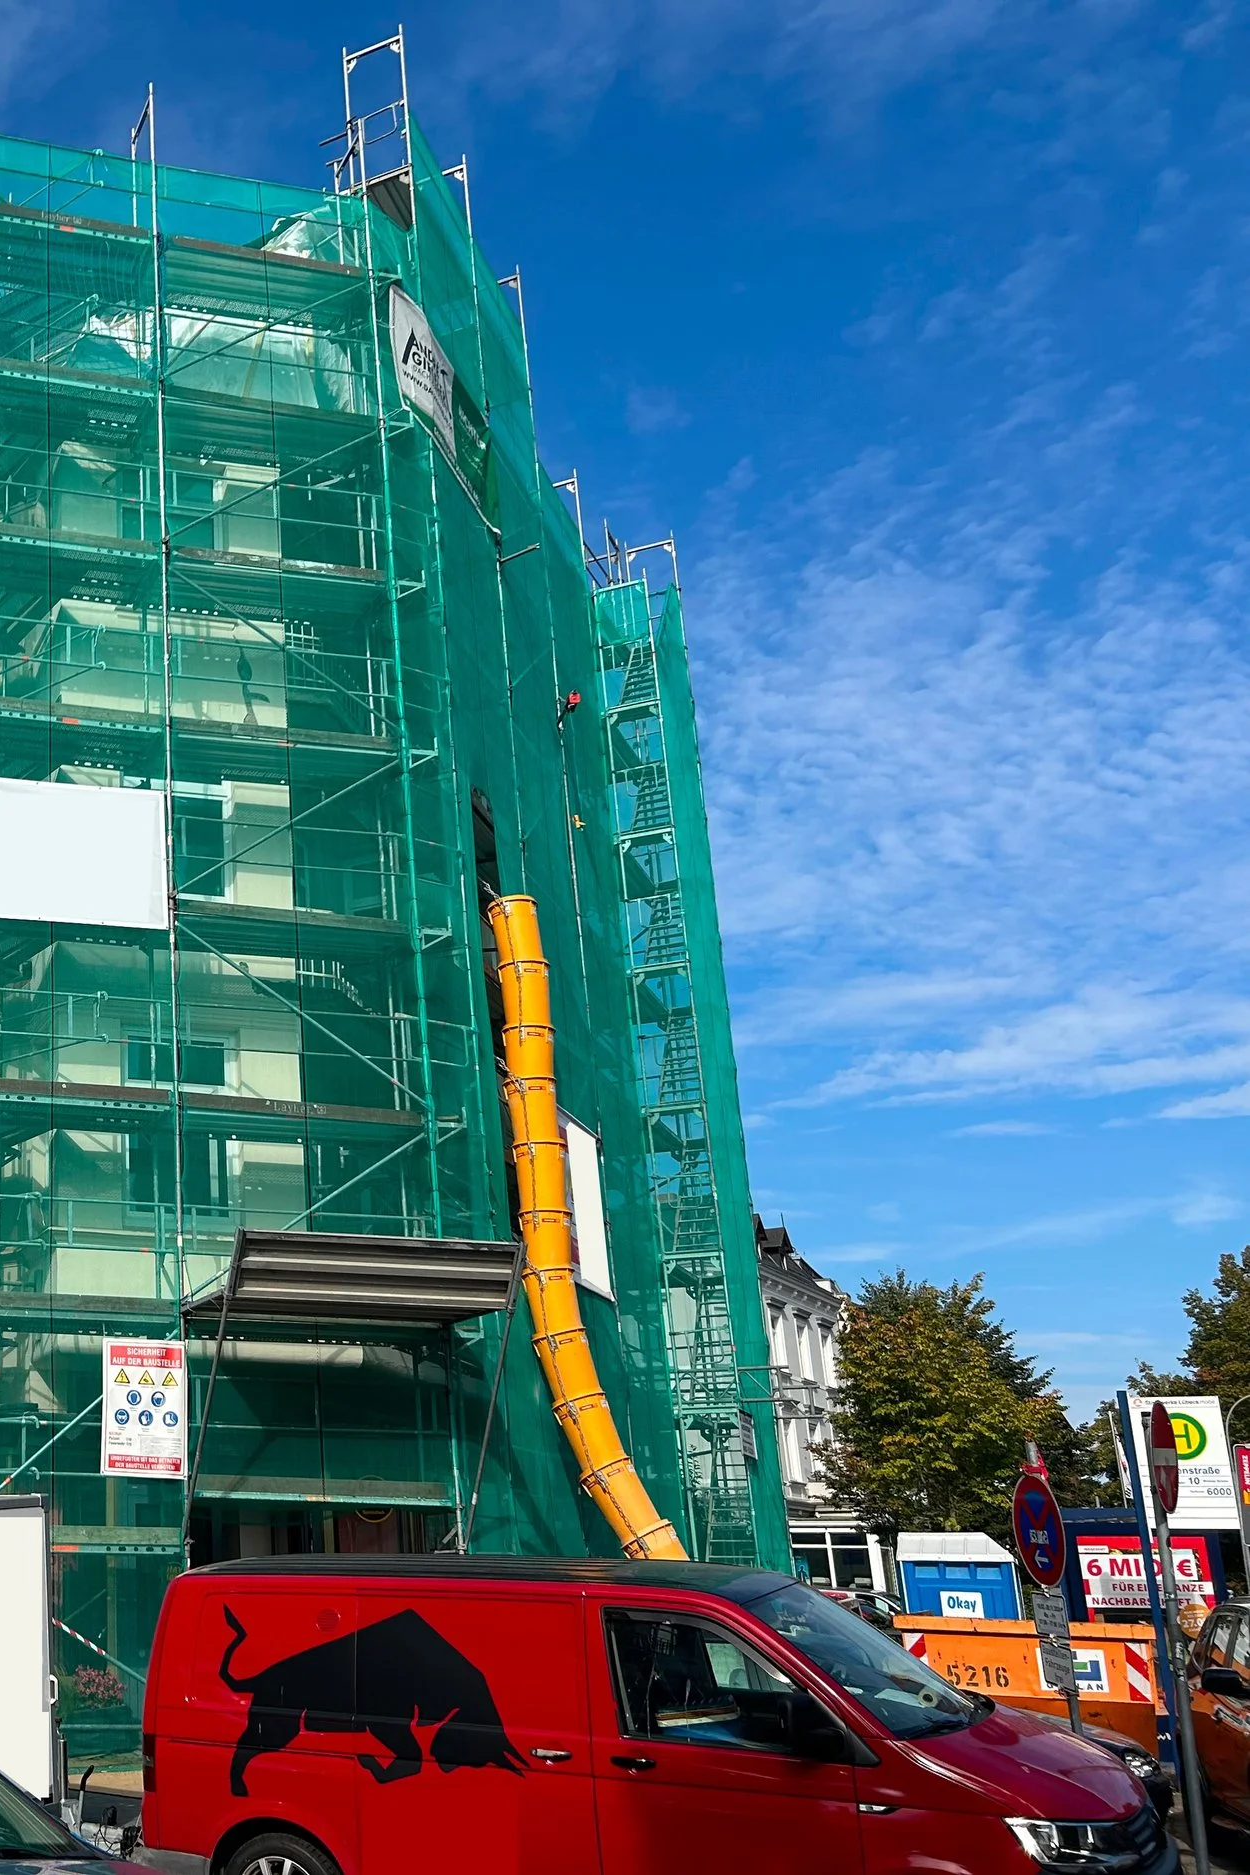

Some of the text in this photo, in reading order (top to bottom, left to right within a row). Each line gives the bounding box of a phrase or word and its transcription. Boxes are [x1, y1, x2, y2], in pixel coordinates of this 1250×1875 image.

[127, 1347, 167, 1357] SICHERHEIT
[112, 1356, 181, 1368] AUF DER BAUSTELLE
[1188, 1477, 1201, 1486] 10
[1206, 1487, 1232, 1496] 6000
[1086, 1558, 1103, 1577] 6
[1176, 1559, 1194, 1577] €
[1112, 1581, 1205, 1593] FÜR EIE ANZE
[947, 1595, 977, 1612] Okay
[946, 1664, 1010, 1688] 5216
